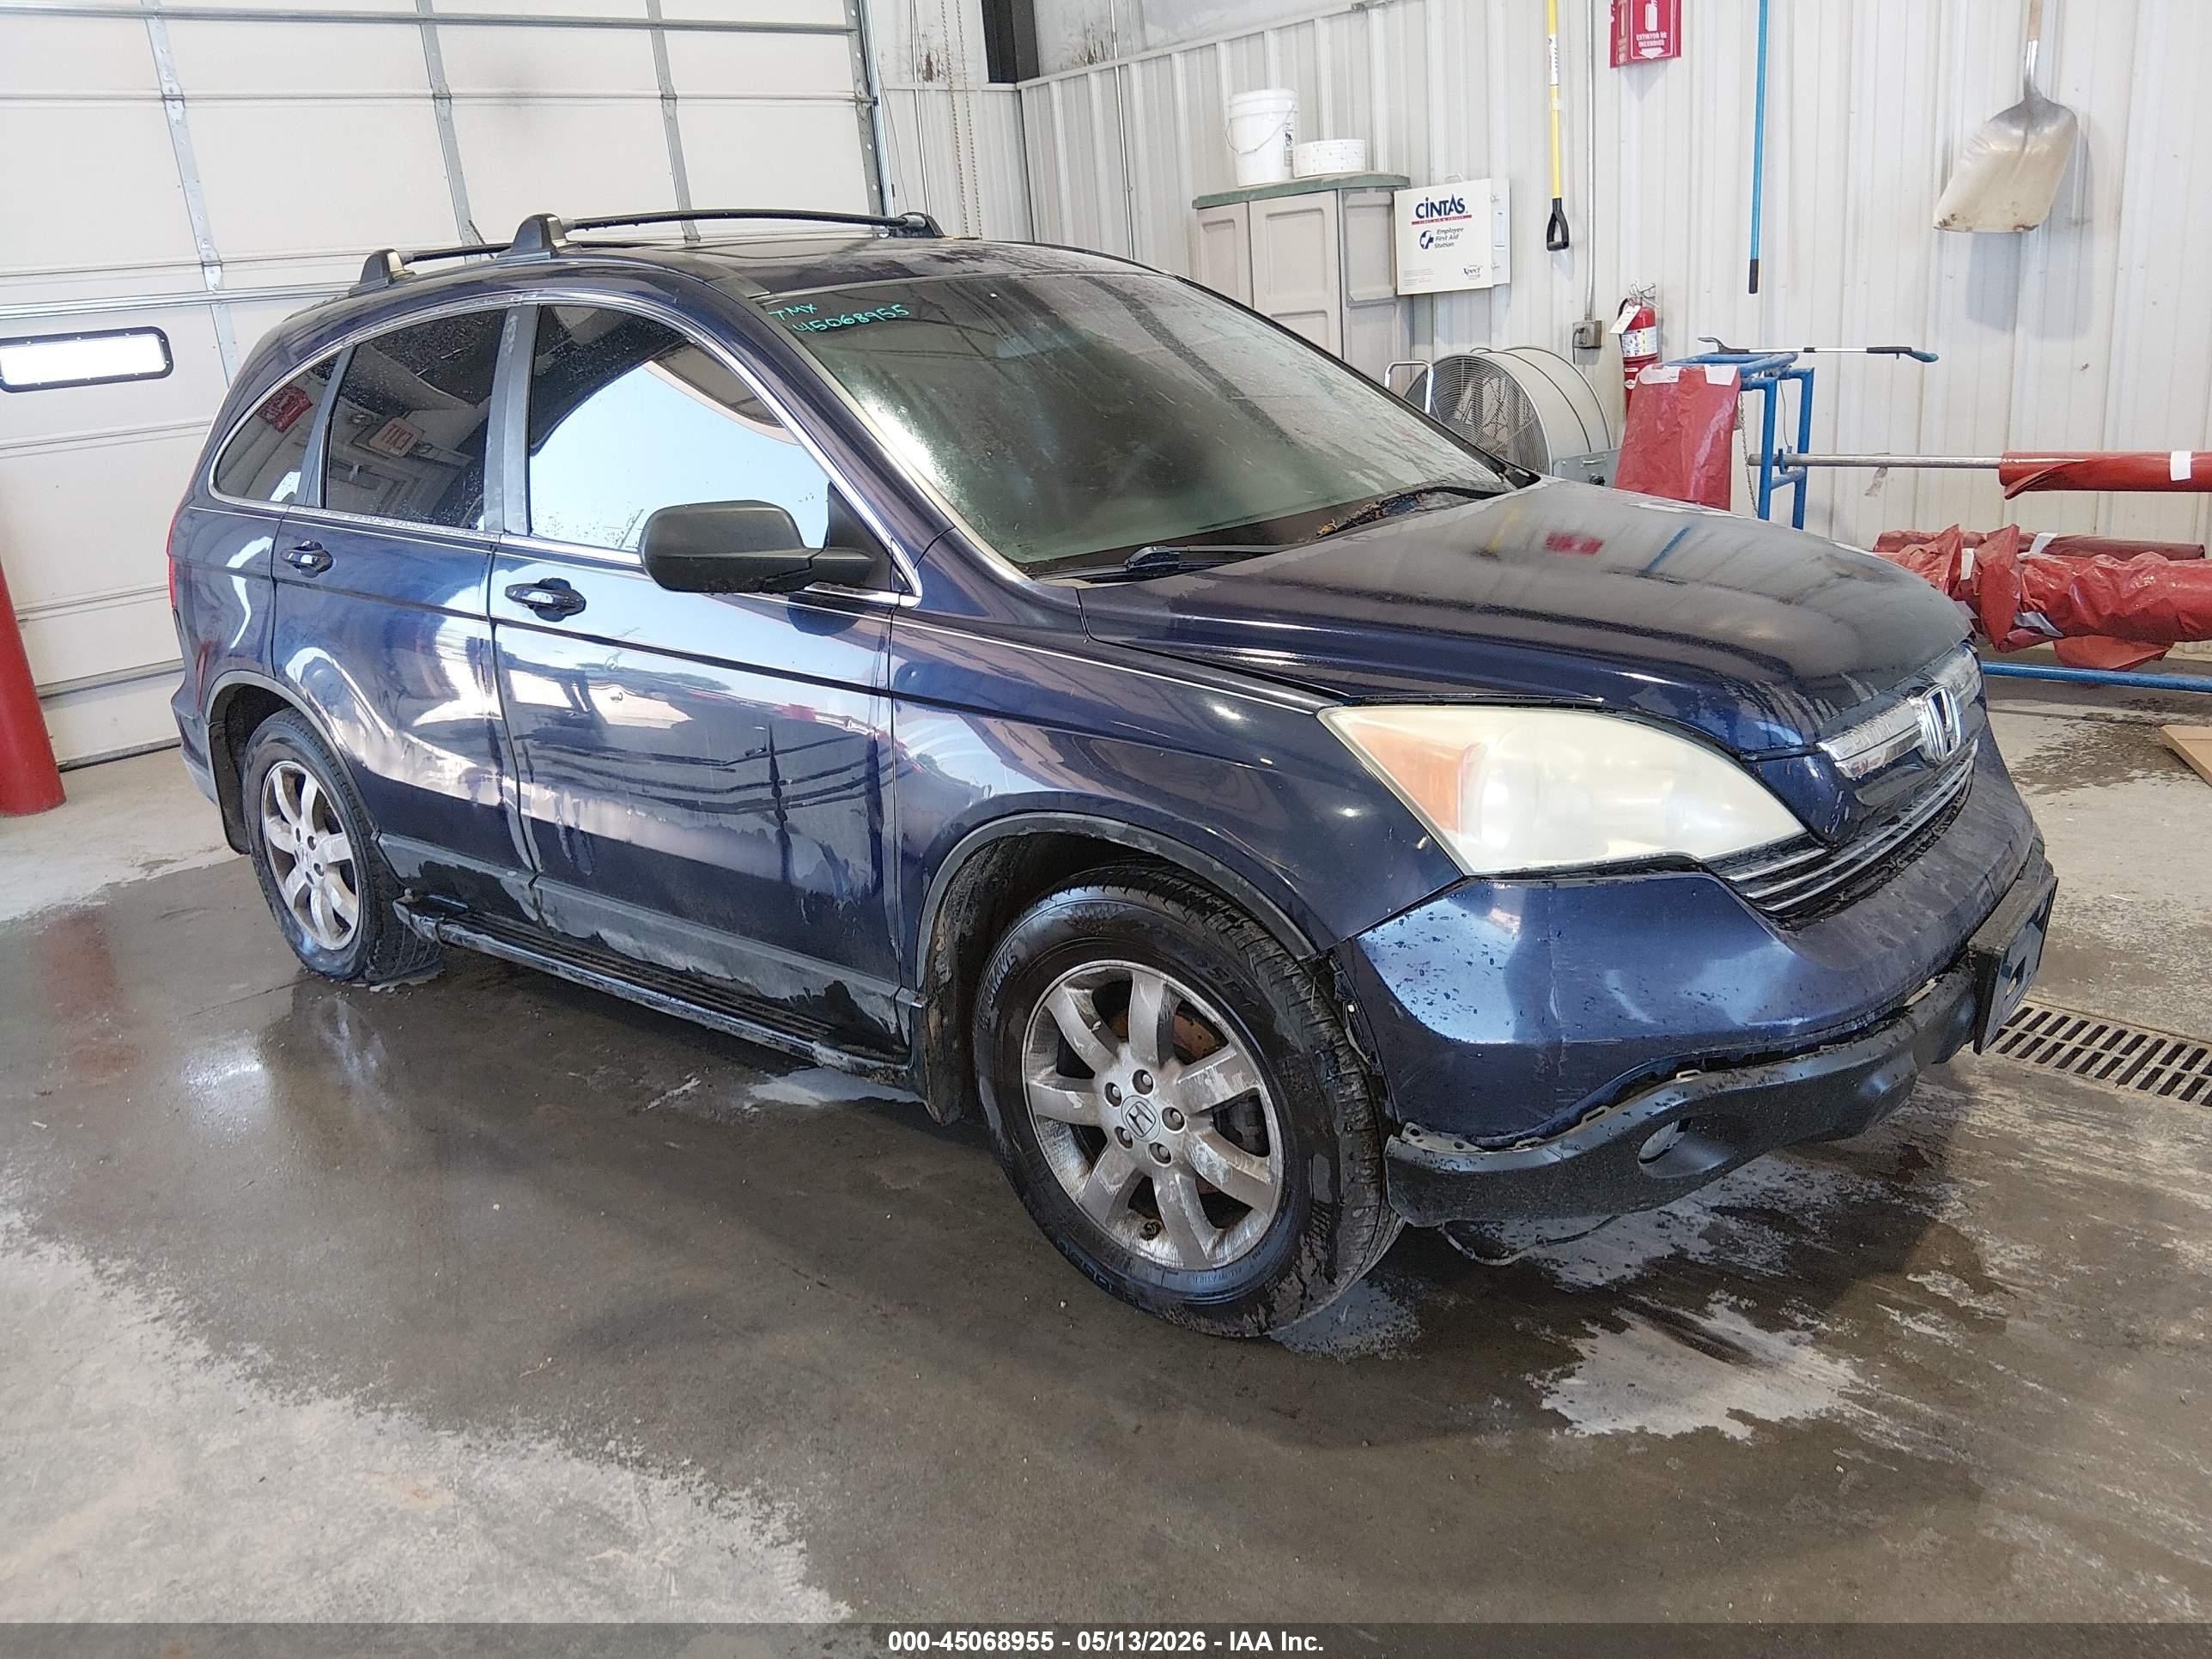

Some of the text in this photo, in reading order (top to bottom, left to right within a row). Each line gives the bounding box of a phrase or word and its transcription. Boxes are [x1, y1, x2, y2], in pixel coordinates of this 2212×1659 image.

[1415, 193, 1466, 219] CINTAS
[1437, 227, 1464, 236] Employee
[769, 302, 818, 322] TMX
[792, 303, 910, 333] 45068955
